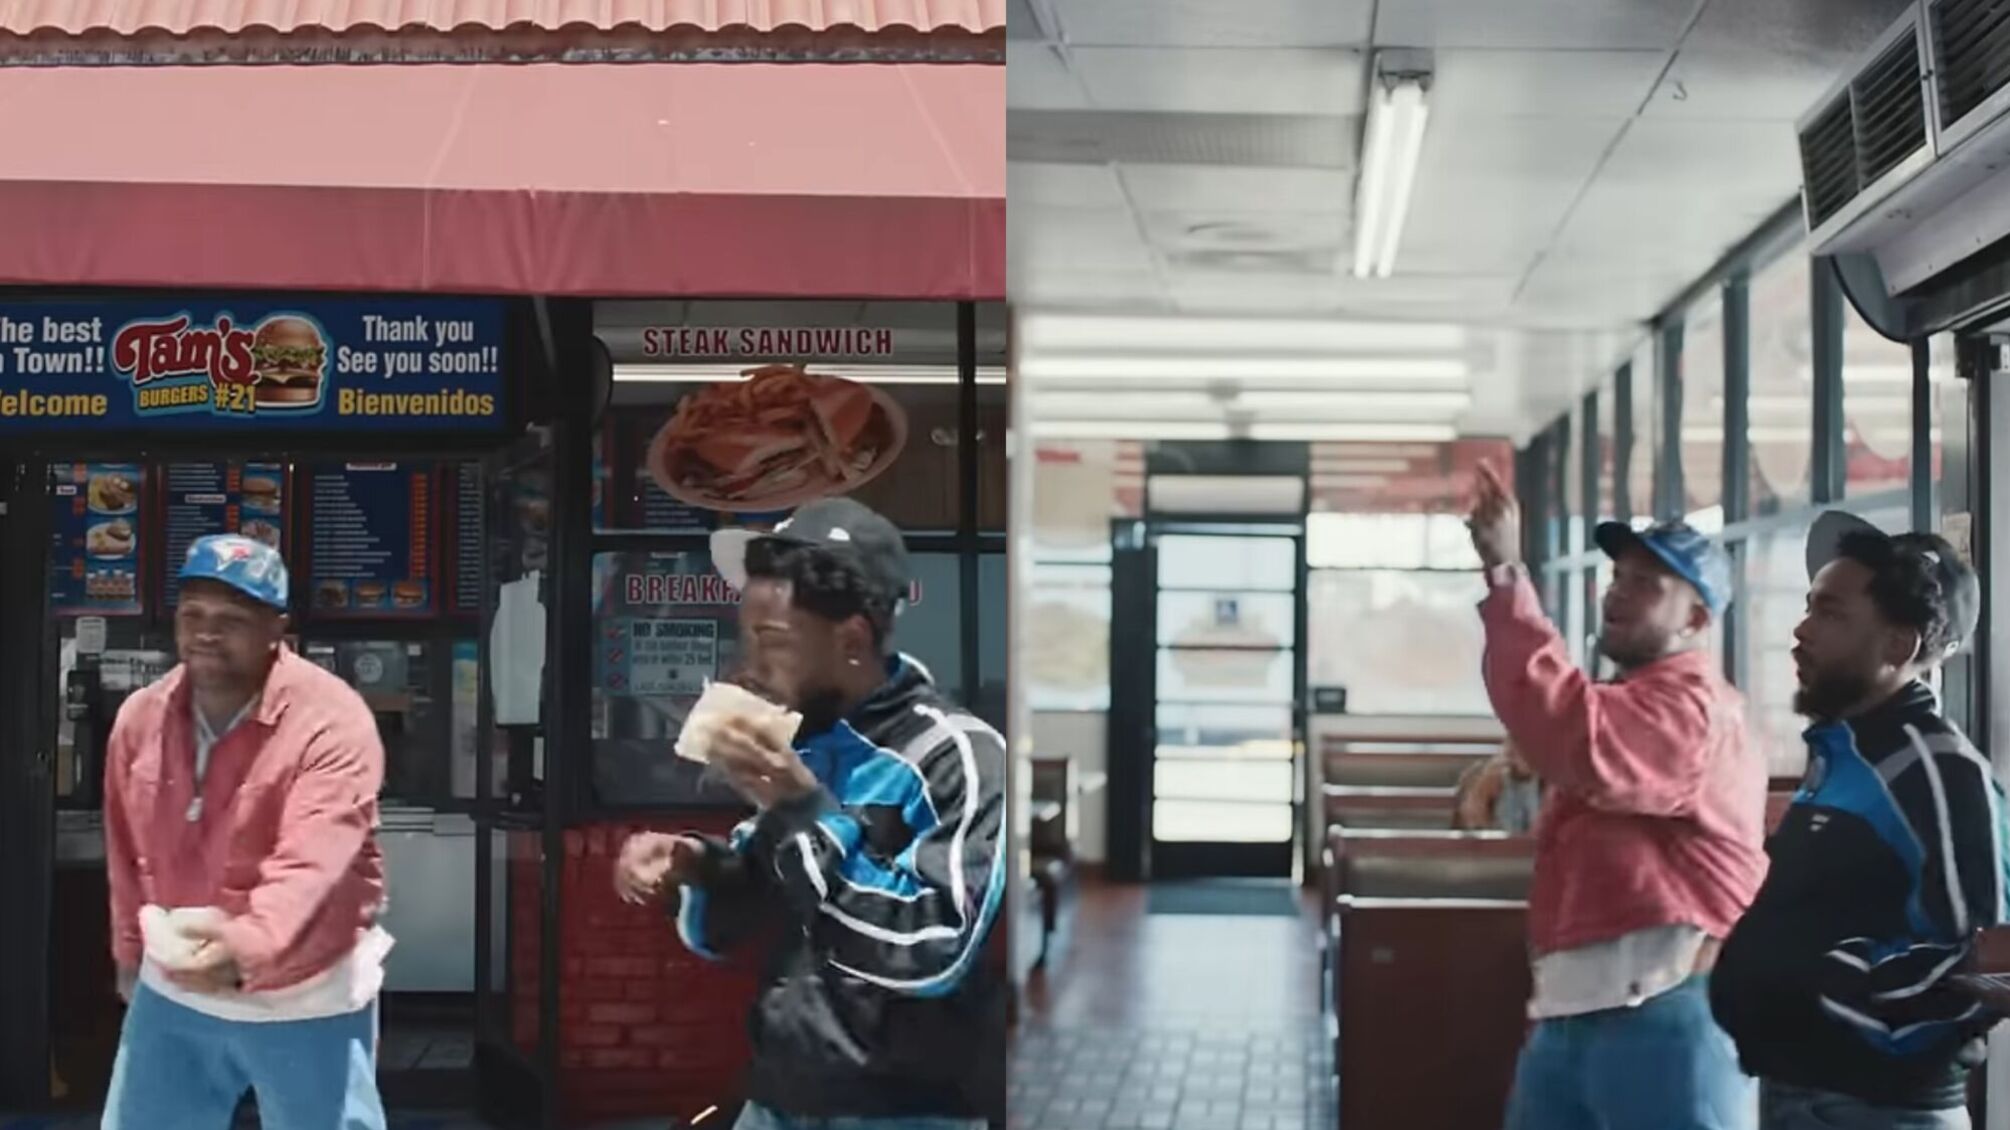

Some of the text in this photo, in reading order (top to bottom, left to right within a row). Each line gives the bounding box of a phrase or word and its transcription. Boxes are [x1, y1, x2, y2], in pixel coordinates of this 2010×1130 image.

[0, 316, 103, 343] he best
[362, 315, 474, 348] Thank you
[642, 327, 893, 355] STEAK SANDWICH
[13, 346, 105, 373] Town!!
[113, 315, 262, 386] Tam's
[337, 345, 498, 379] See you soon!!
[0, 389, 108, 416] elcome
[138, 382, 257, 412] BURGERS #21
[338, 387, 495, 415] Bienvenidos
[632, 622, 716, 639] NO SMOKING
